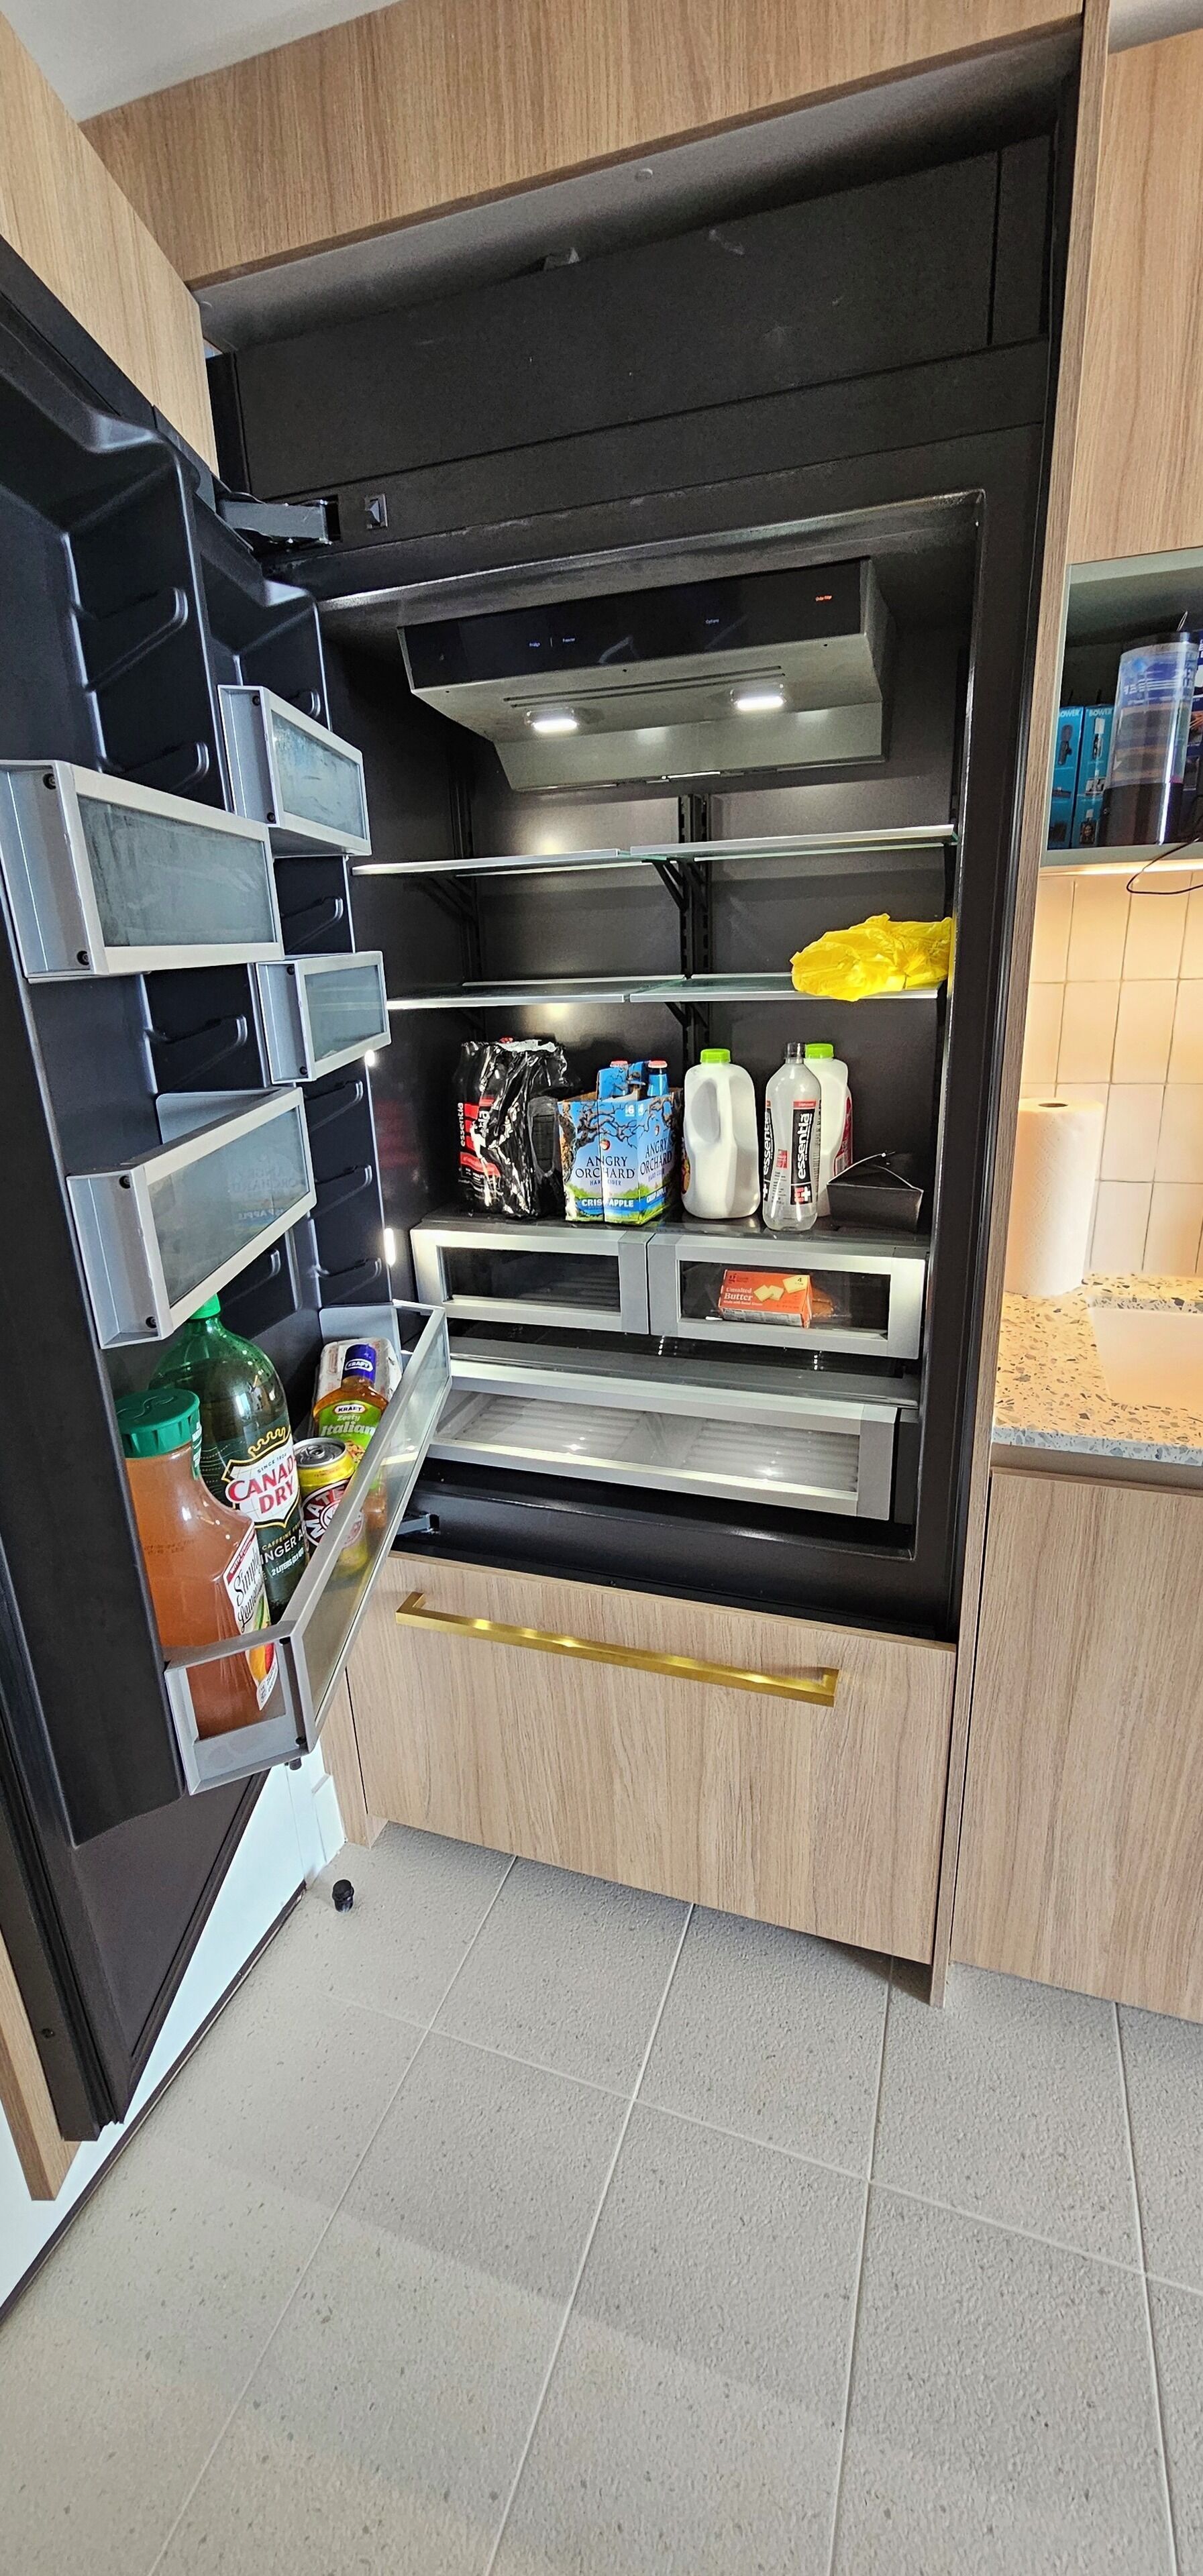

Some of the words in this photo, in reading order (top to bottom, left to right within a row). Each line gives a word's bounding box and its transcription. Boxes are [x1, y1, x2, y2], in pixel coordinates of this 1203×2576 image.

[1059, 708, 1080, 718] OWER
[645, 1136, 668, 1159] ANGRY
[797, 1112, 810, 1179] essentia
[586, 1155, 628, 1167] ANGRY
[639, 1150, 673, 1175] ORCHARD
[575, 1167, 635, 1179] ORCHARD
[581, 1199, 602, 1207] CRIS
[609, 1199, 634, 1208] APPLE
[724, 1293, 753, 1301] Butter
[348, 1360, 369, 1368] KRAFT
[321, 1421, 376, 1436] Italian
[257, 1460, 275, 1473] SINCE
[228, 1454, 297, 1501] CANAD
[258, 1475, 293, 1514] DRY
[262, 1530, 291, 1550] CAFFEINE
[260, 1536, 297, 1564] INGER
